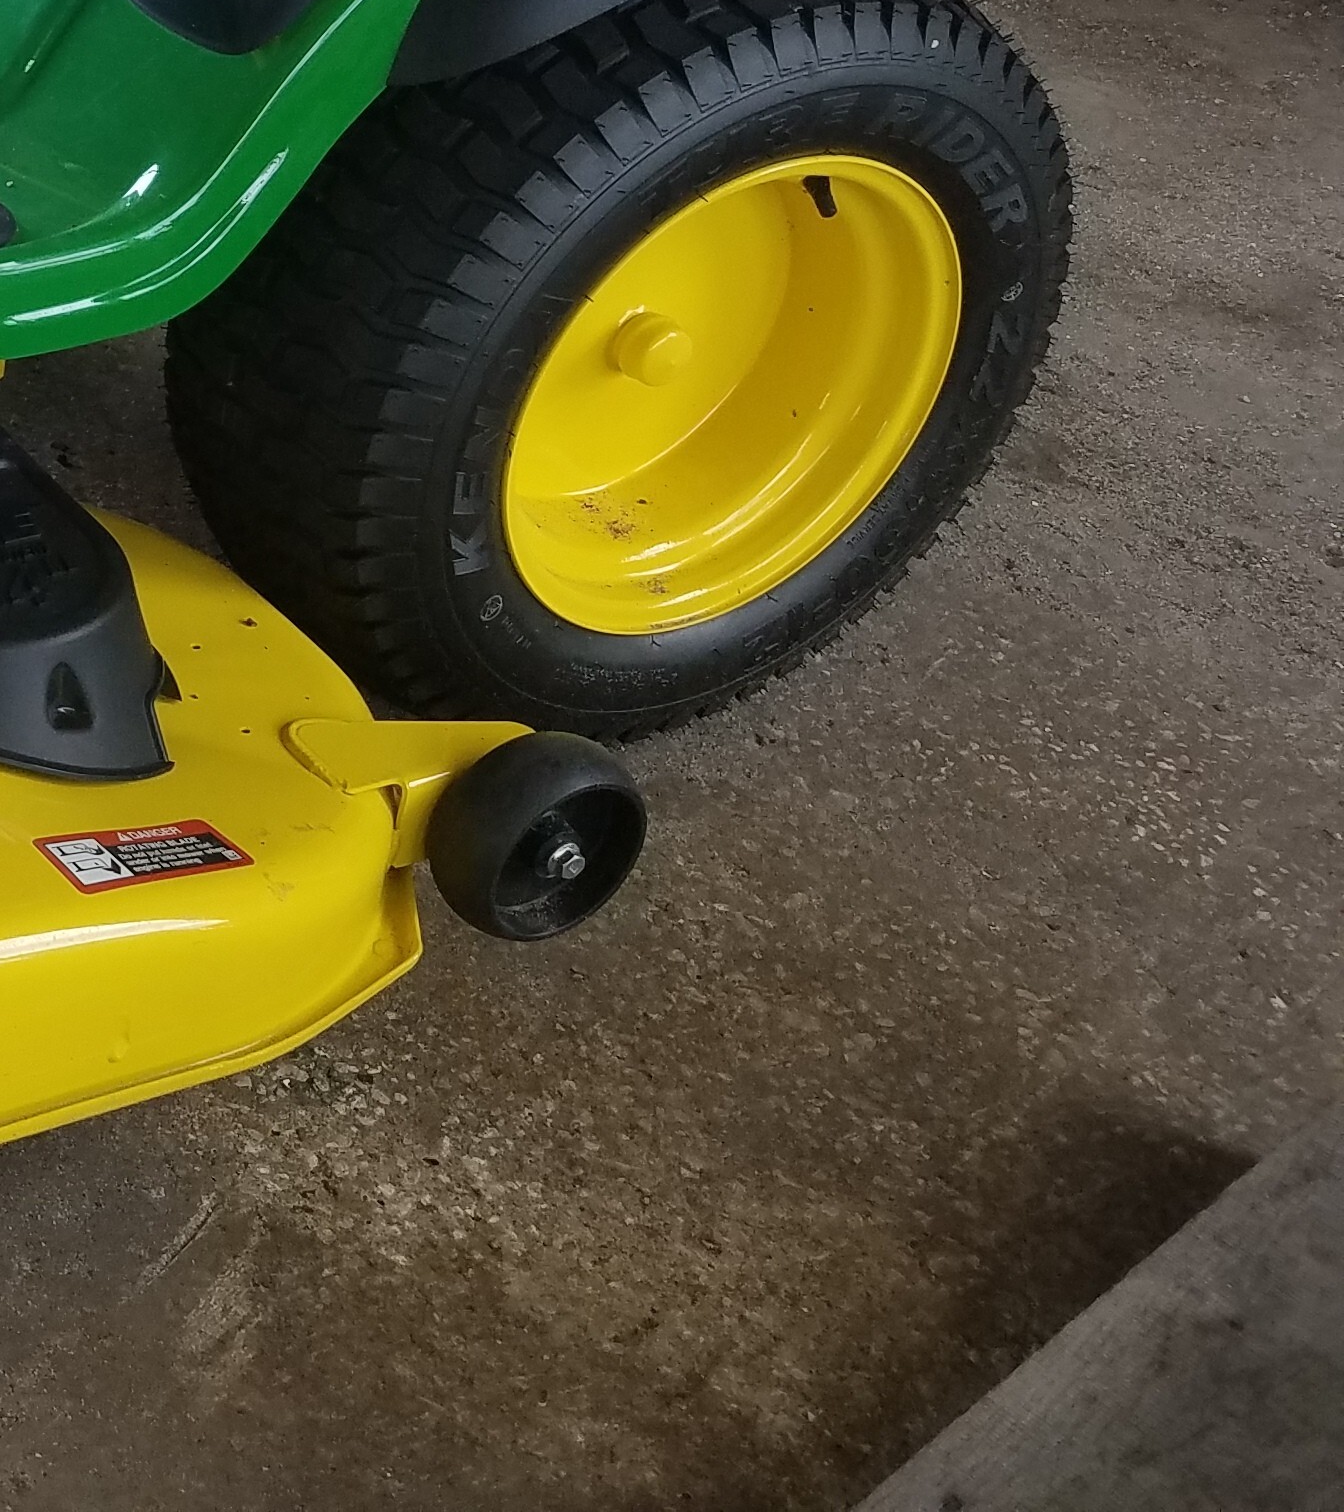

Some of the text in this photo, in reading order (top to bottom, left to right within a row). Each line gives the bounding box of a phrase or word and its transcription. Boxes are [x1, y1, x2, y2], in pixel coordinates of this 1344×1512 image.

[869, 91, 1029, 233] RIDER
[128, 827, 182, 840] DANGER
[117, 836, 201, 853] ROTATING BLADE
